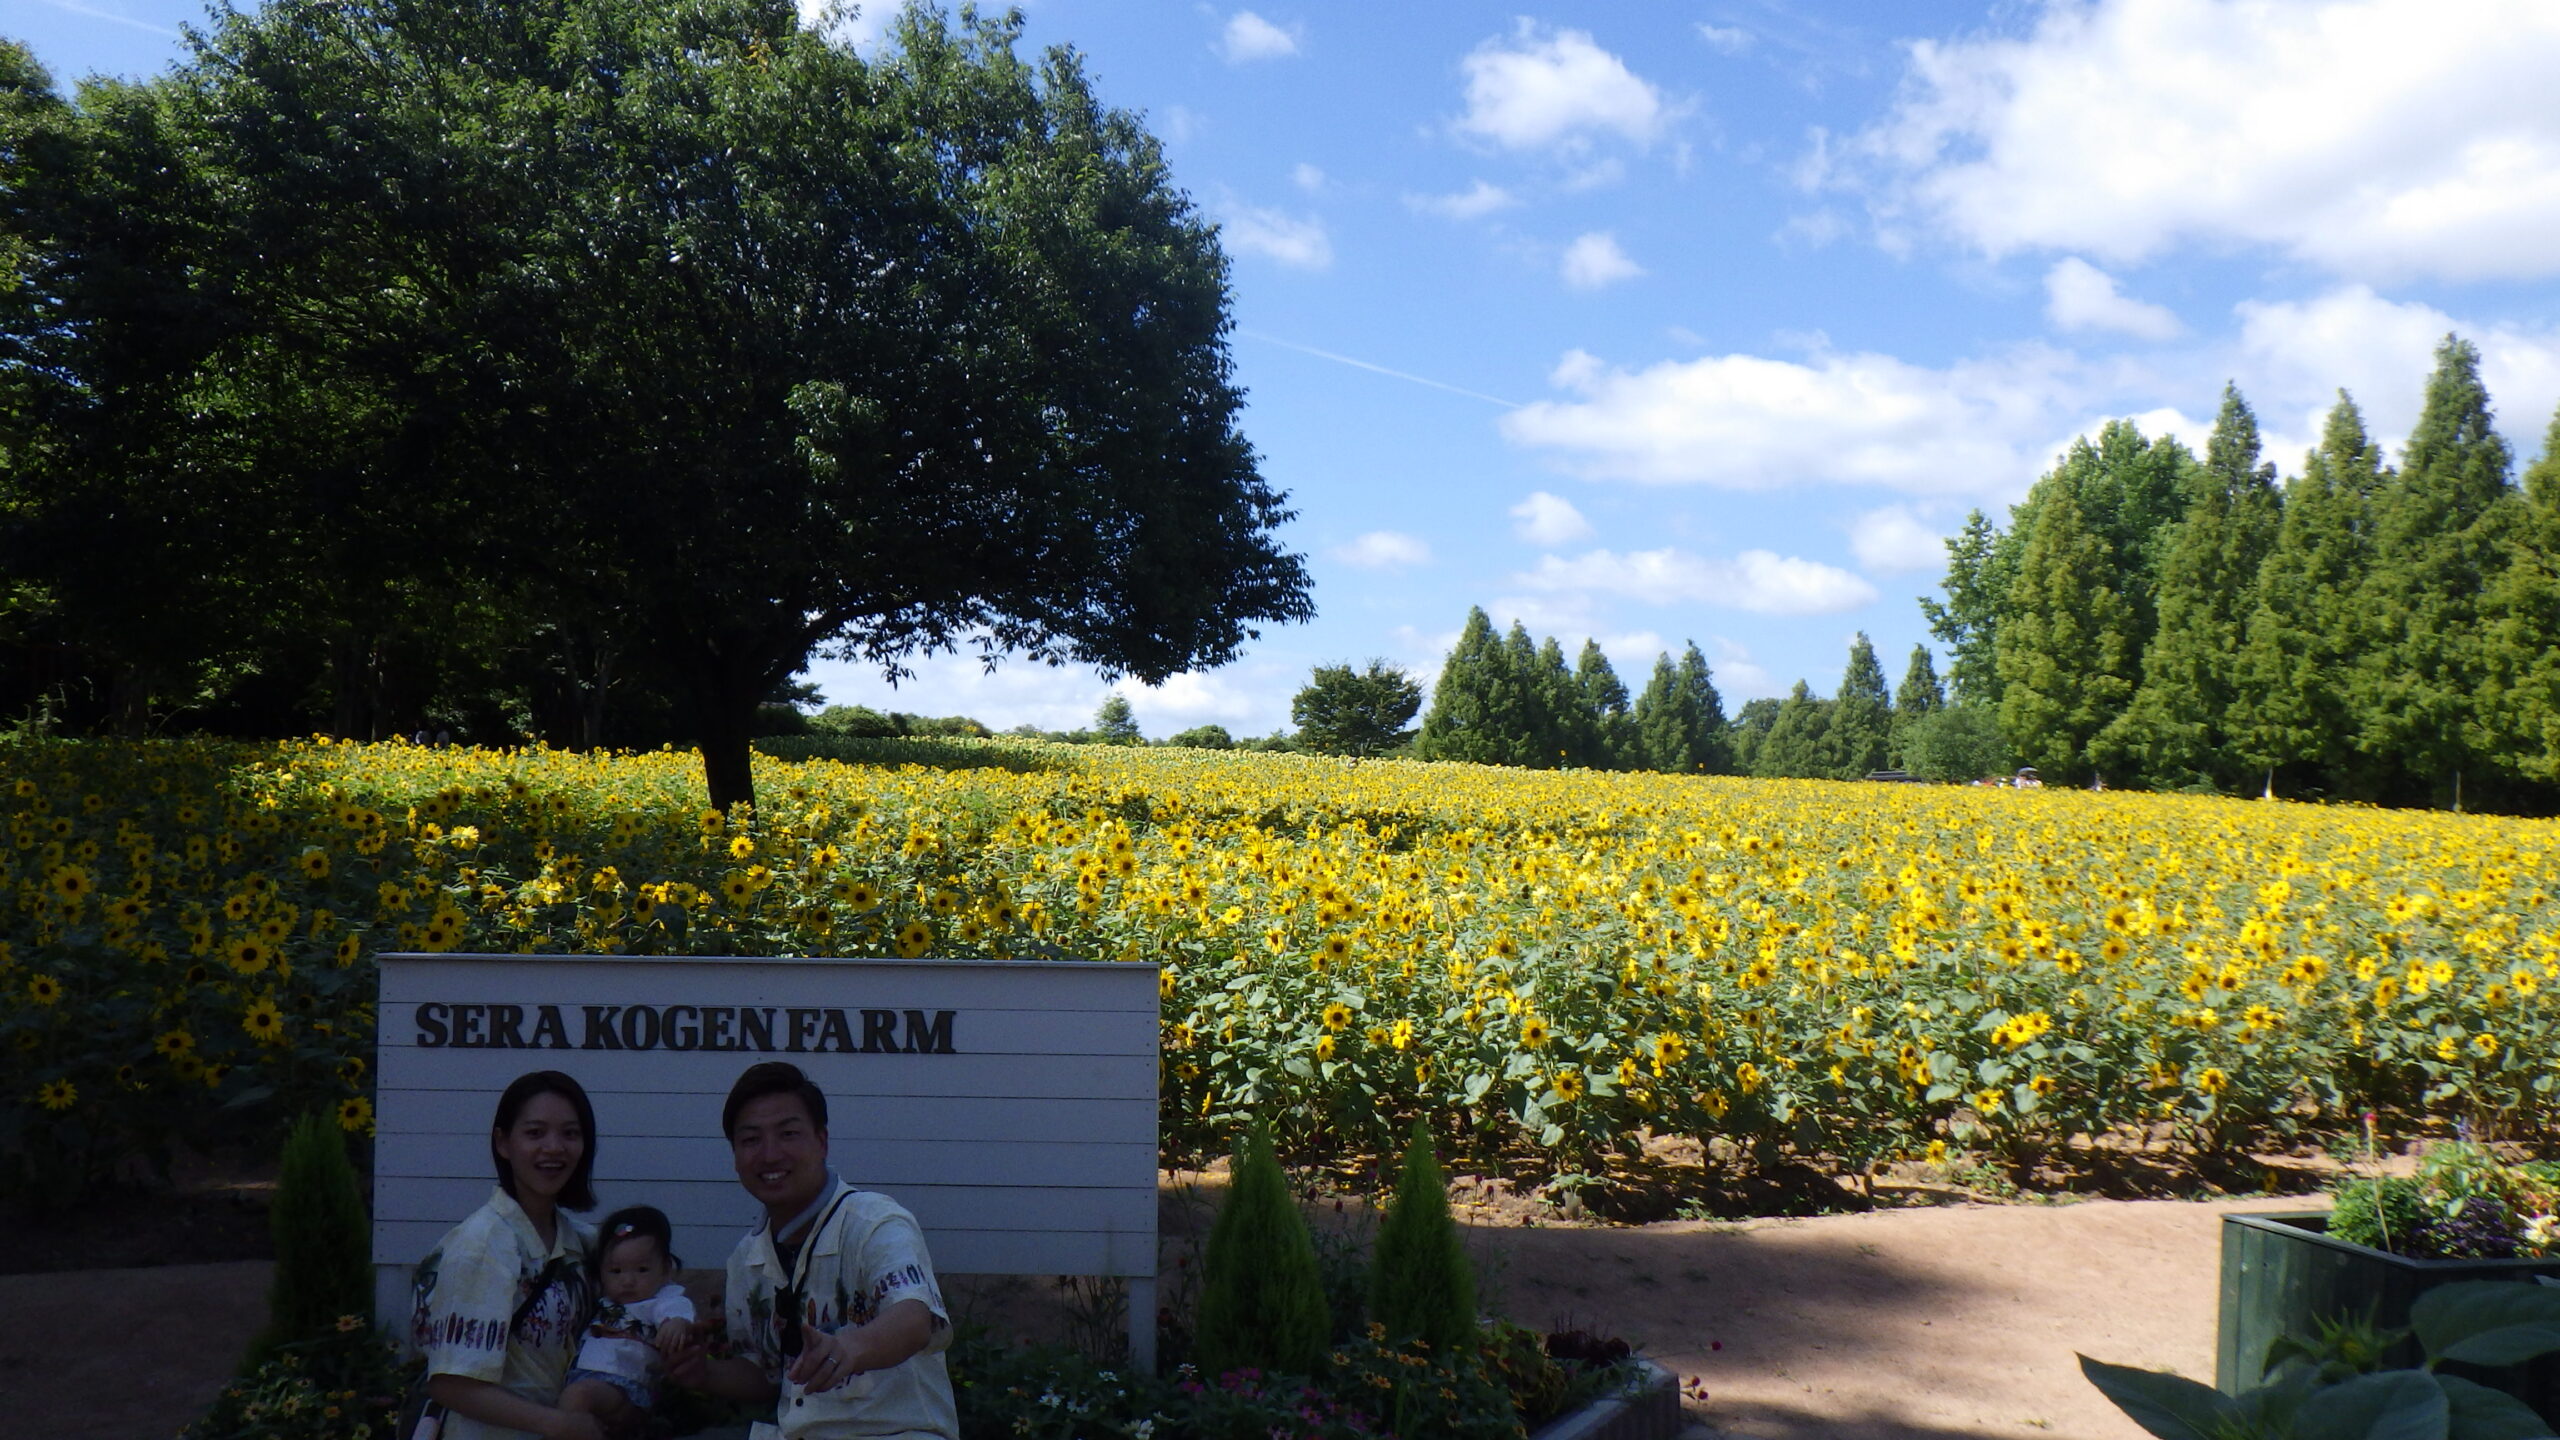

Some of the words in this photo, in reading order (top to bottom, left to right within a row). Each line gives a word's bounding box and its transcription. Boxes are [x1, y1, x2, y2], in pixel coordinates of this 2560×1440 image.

[416, 1002, 570, 1049] SERA
[581, 1005, 775, 1052] KOGEN
[785, 1008, 957, 1054] FARM
